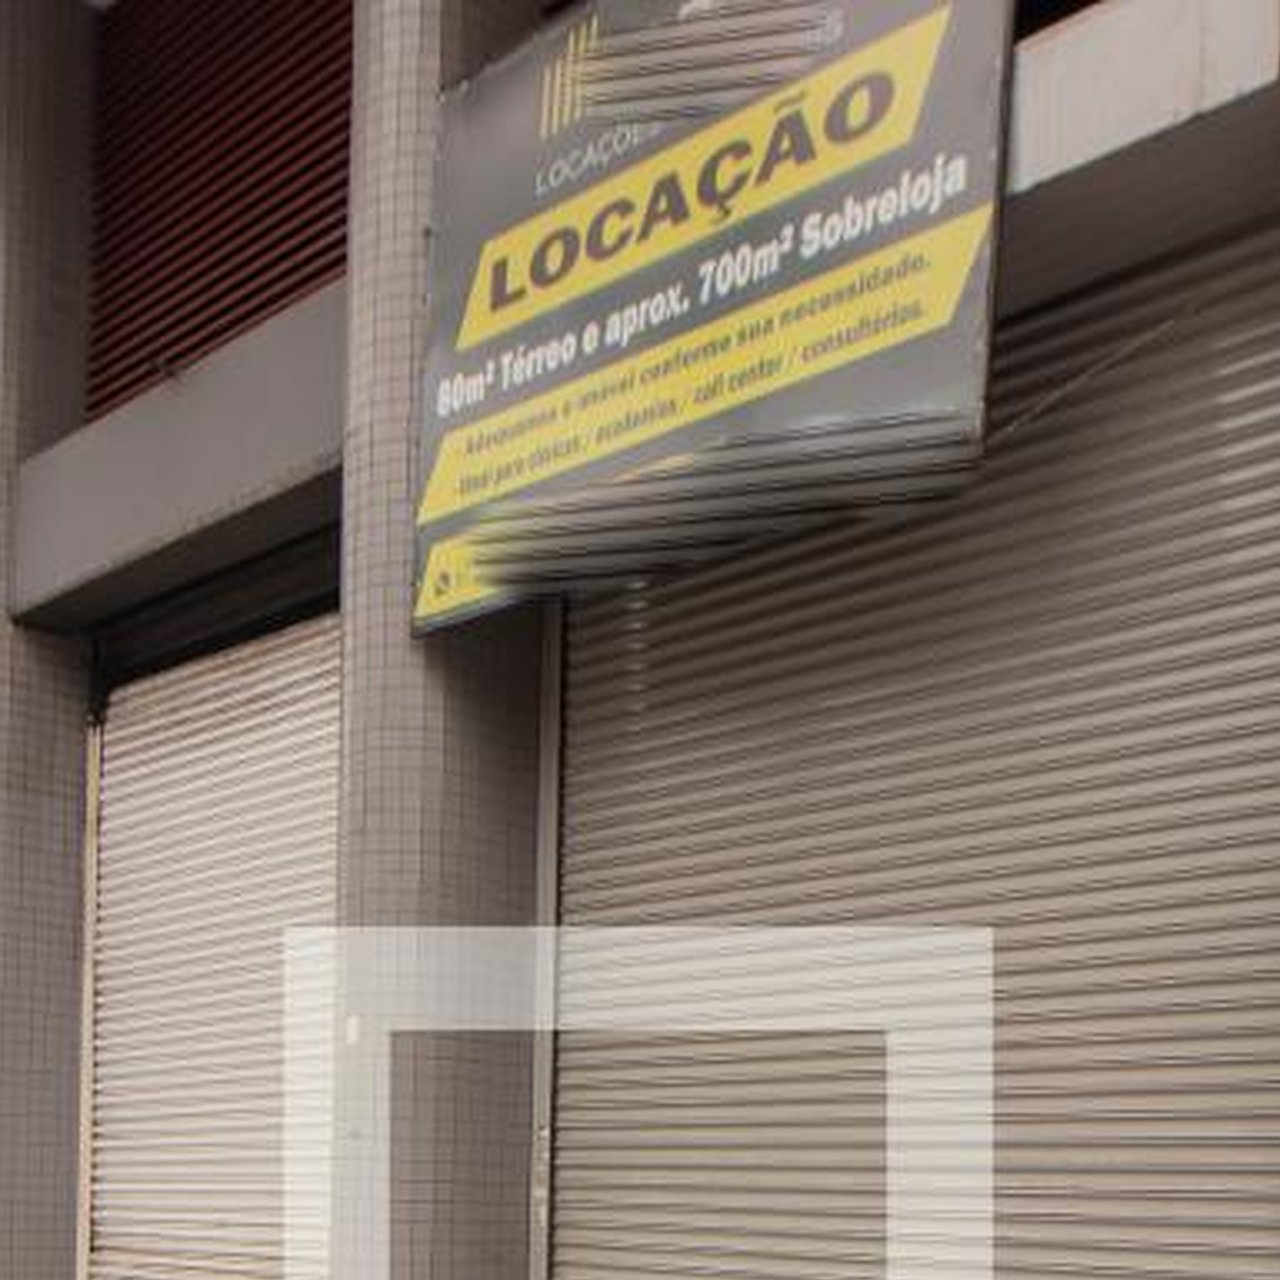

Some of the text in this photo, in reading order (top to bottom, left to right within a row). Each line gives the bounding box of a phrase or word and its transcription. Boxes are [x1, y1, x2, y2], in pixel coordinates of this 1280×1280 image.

[489, 72, 896, 312] LOCAÇÃO
[604, 281, 691, 347] aprox.
[698, 222, 796, 305] 700m²
[799, 153, 968, 259] Sobreloja
